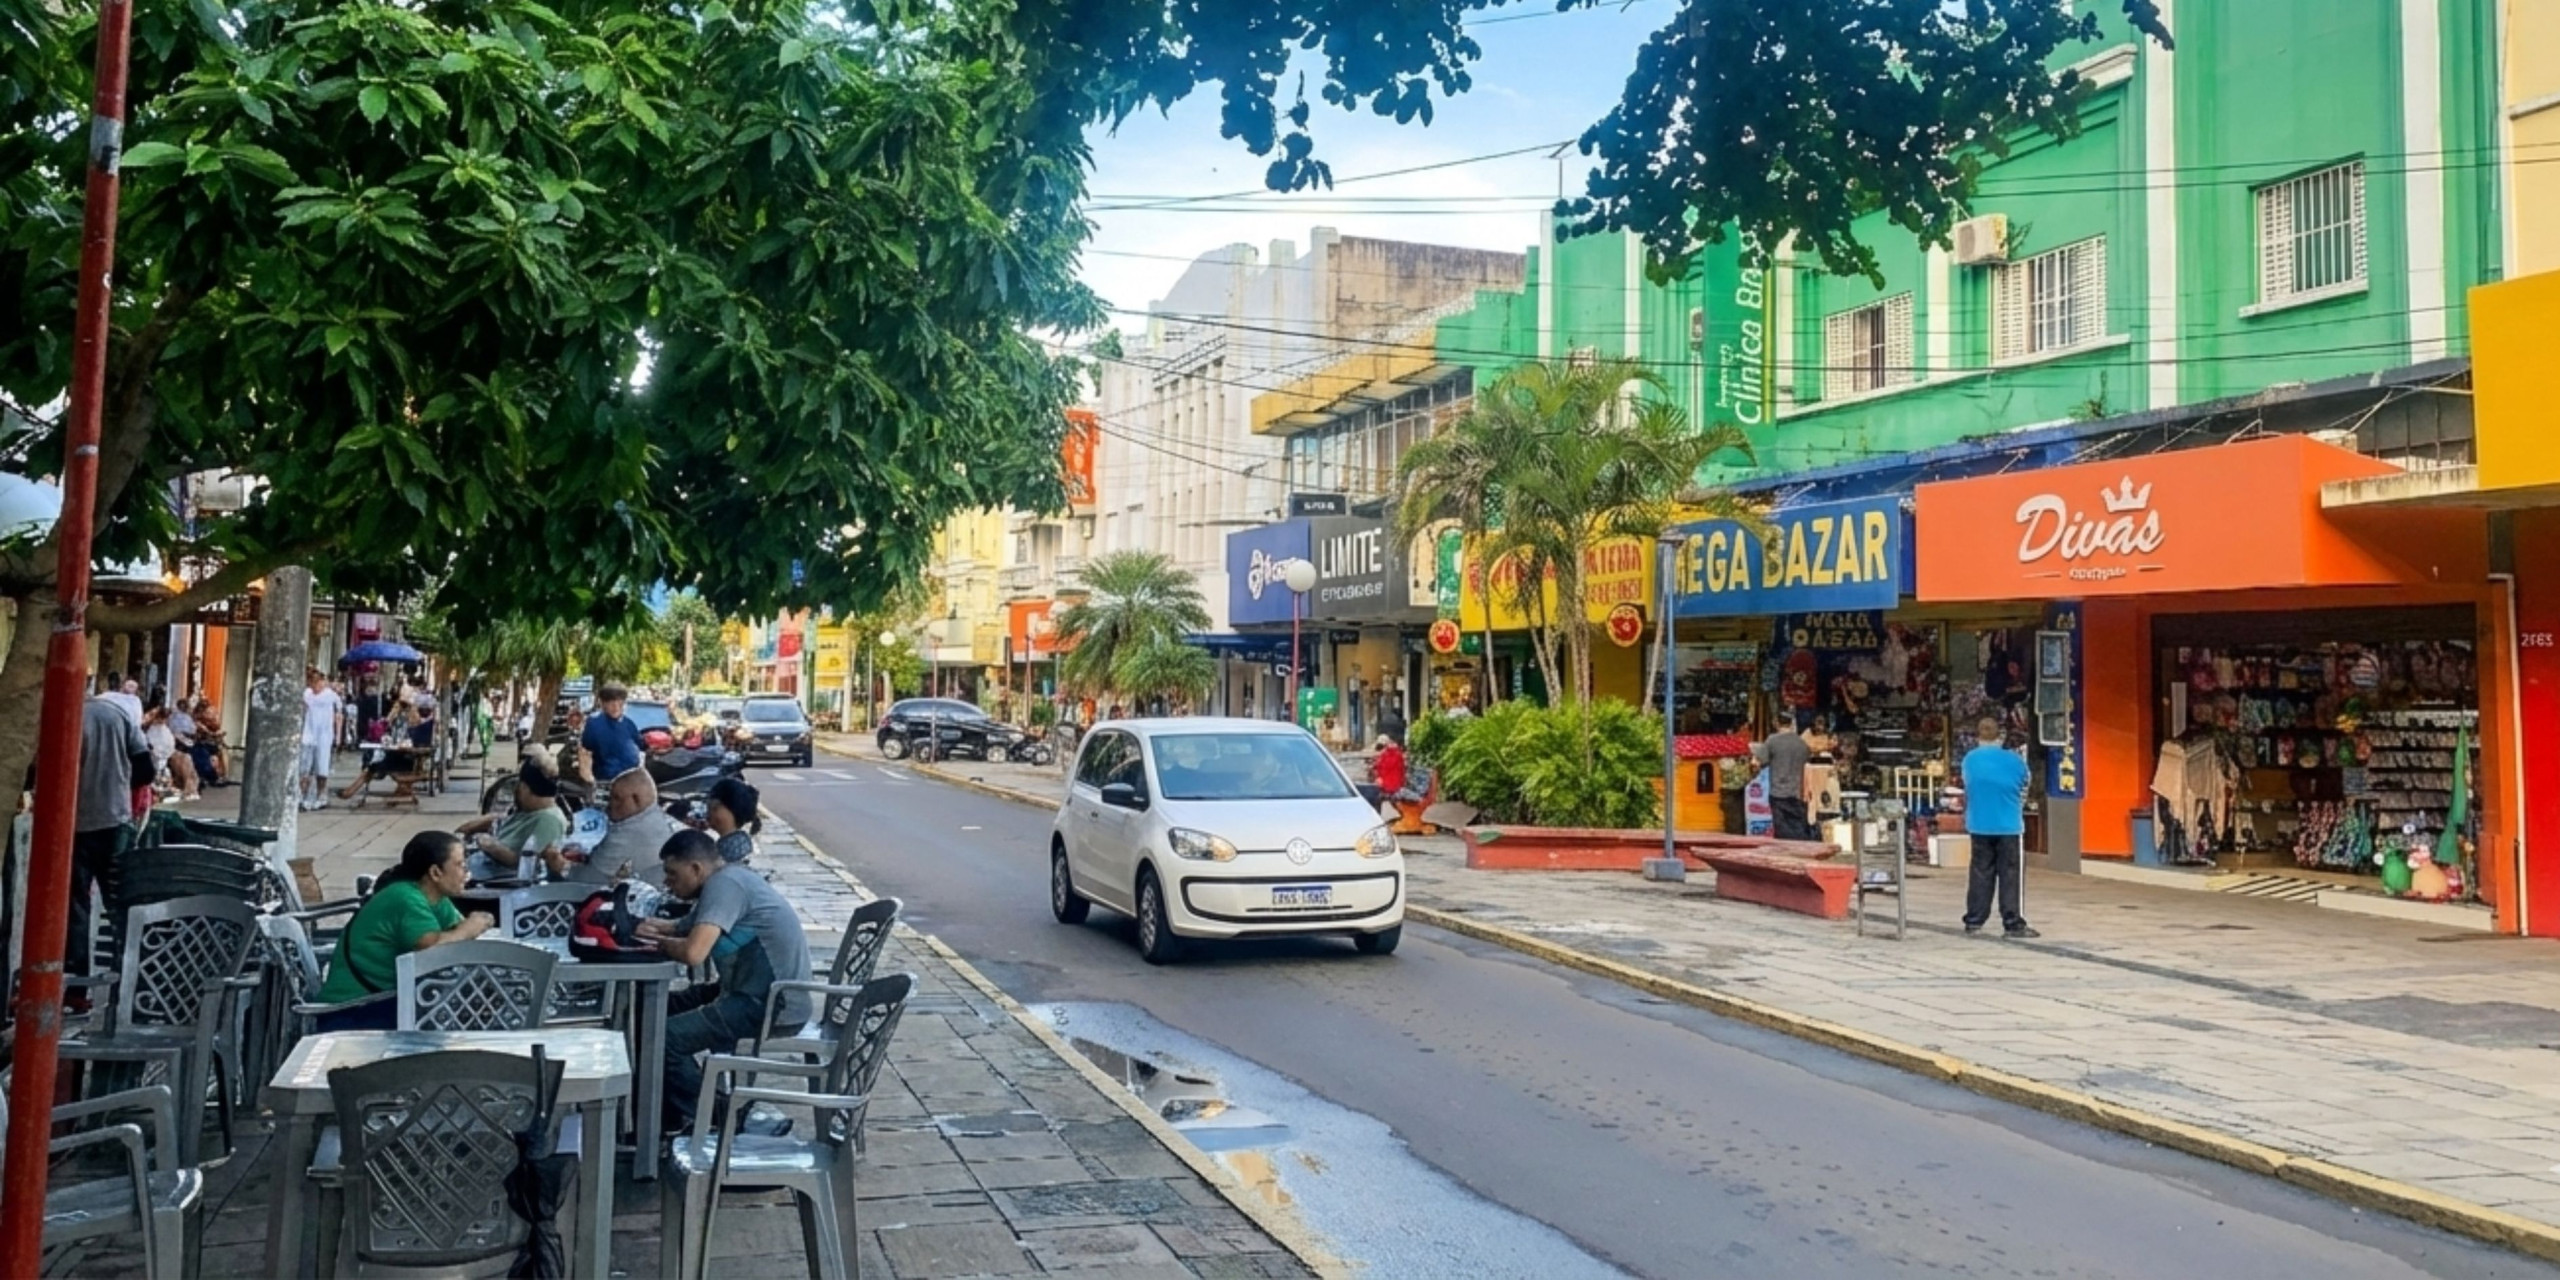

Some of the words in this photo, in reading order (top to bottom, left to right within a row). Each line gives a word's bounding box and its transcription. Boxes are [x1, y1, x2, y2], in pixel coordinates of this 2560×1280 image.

[1321, 527, 1383, 579] LIMITE
[1762, 511, 1889, 589] BAZAR
[2016, 493, 2166, 563] Divas
